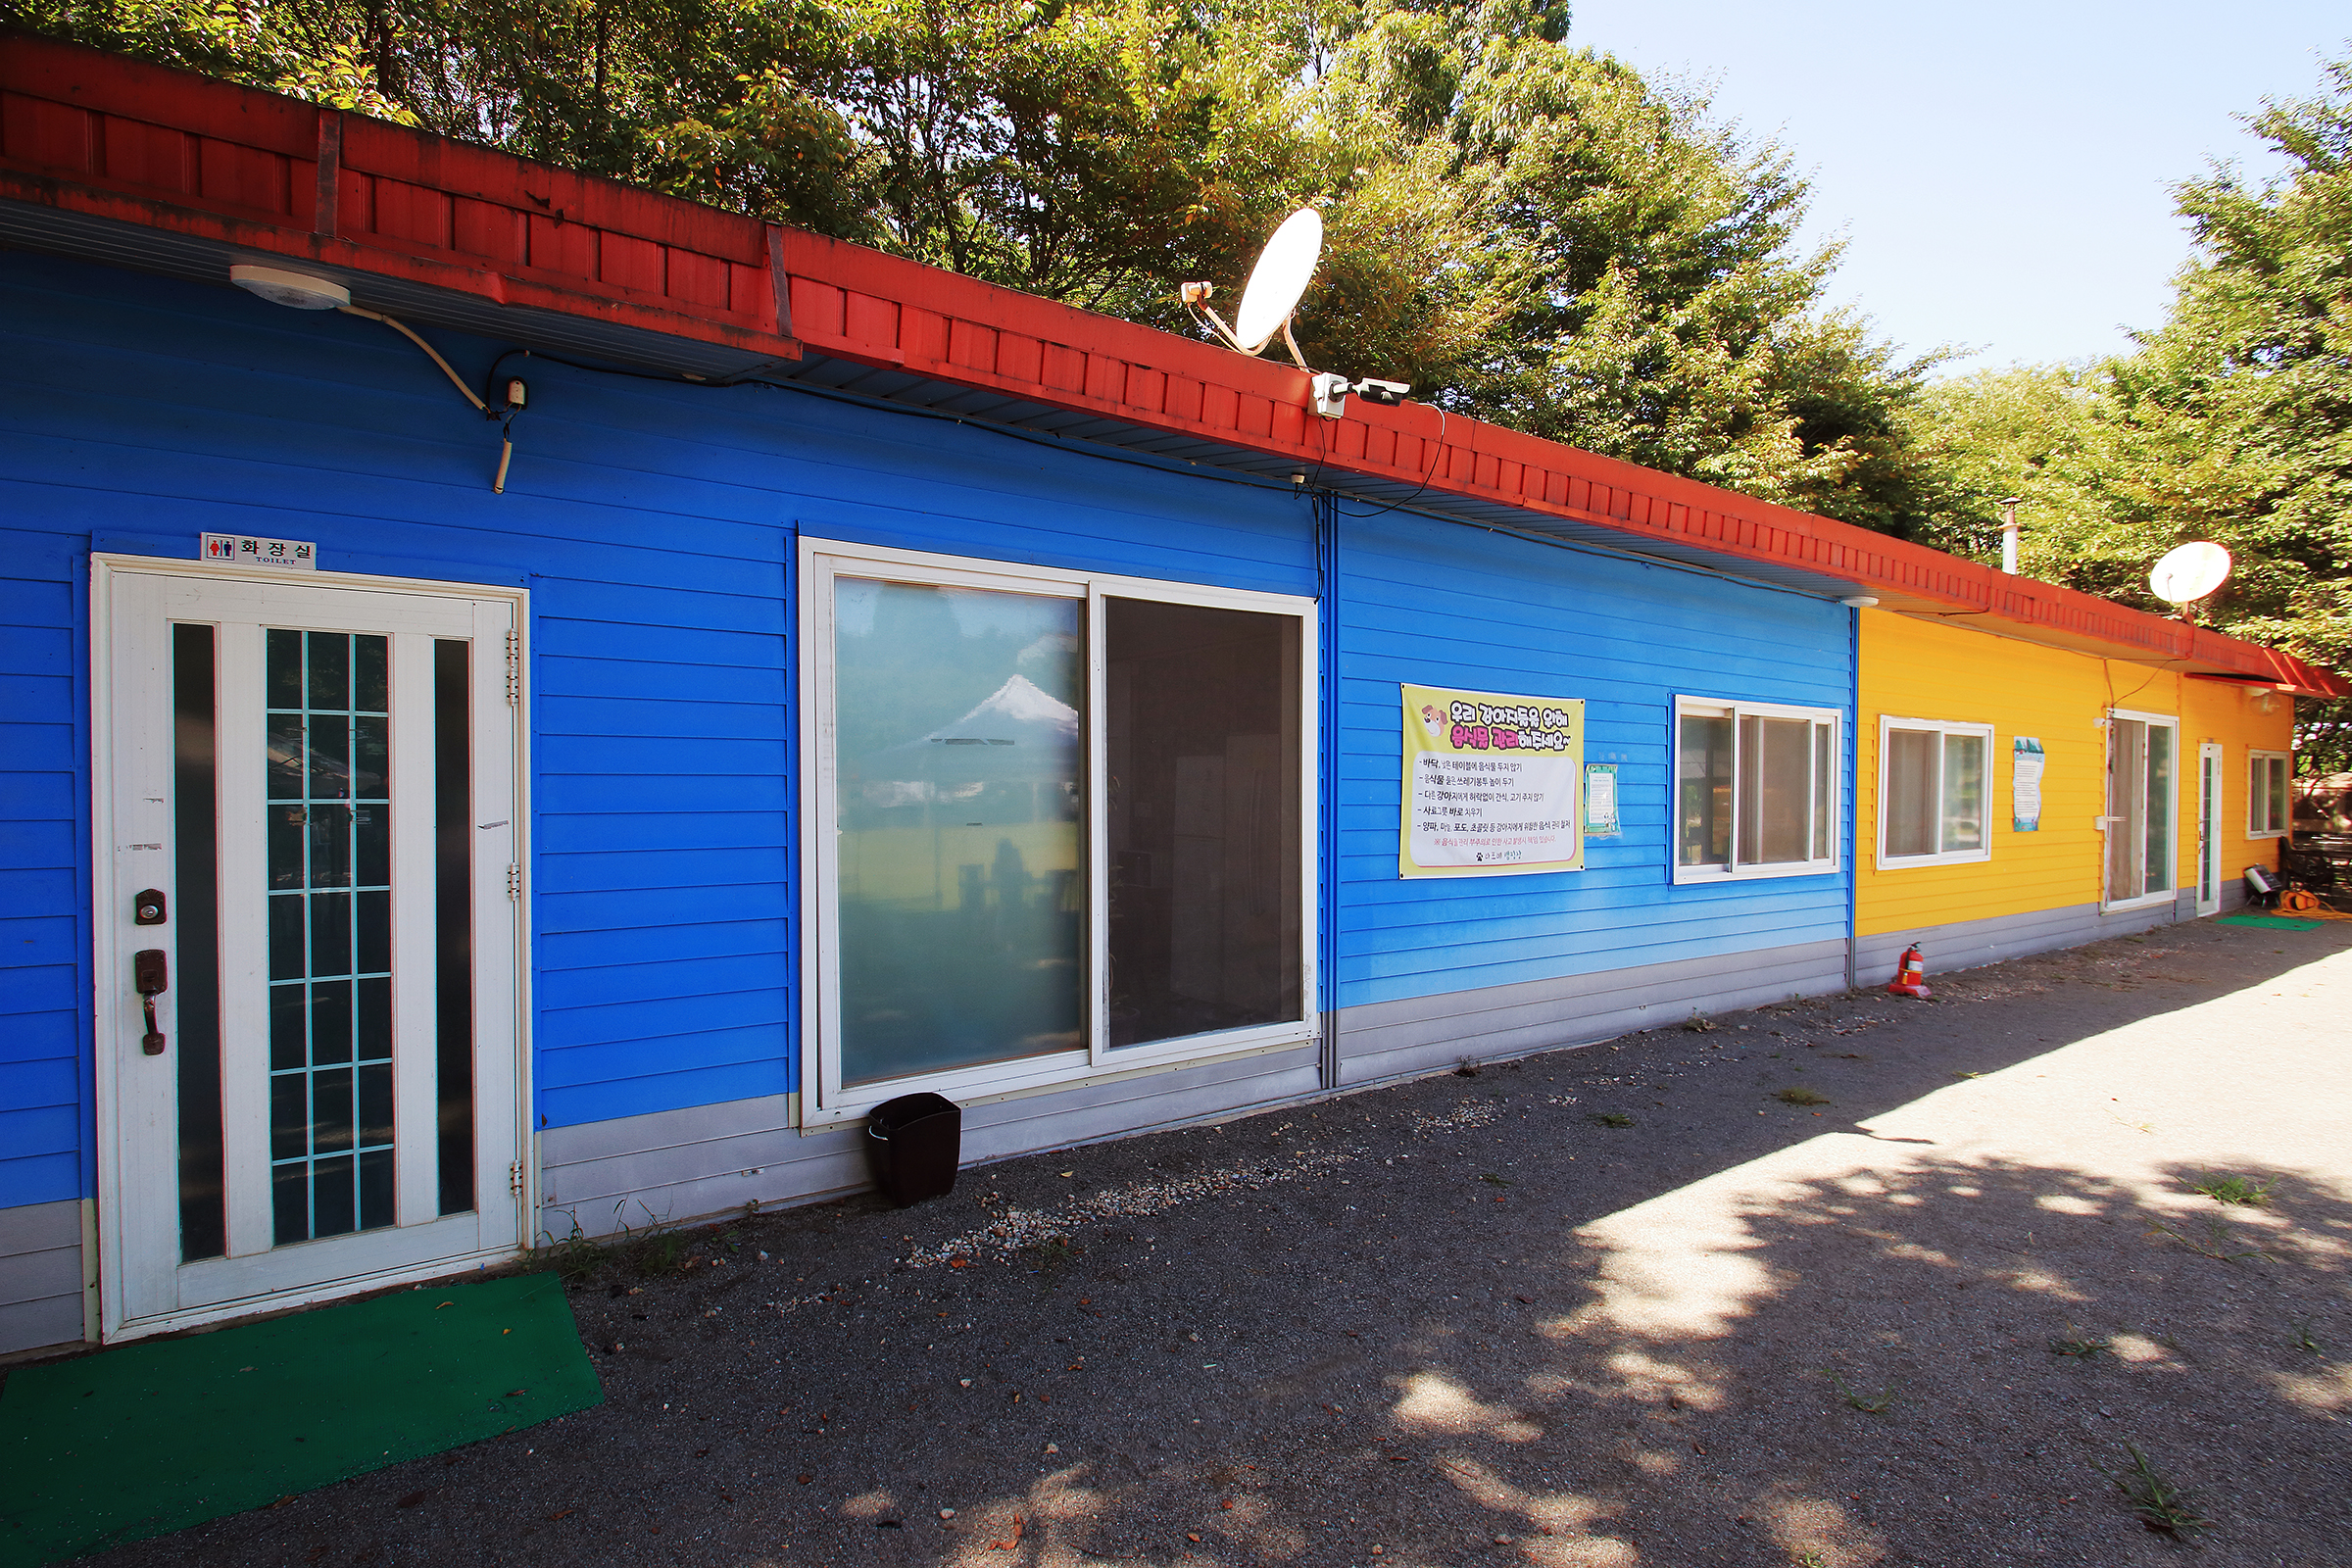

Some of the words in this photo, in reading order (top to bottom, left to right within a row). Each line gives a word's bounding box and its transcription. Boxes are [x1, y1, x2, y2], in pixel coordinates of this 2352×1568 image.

[241, 540, 311, 559] 화장실
[1450, 701, 1476, 723] 우리
[1478, 703, 1541, 728] 강아지들을
[1543, 708, 1568, 729] 위해
[1450, 725, 1489, 749] 음식물
[1452, 761, 1477, 770] 테이블에
[1479, 761, 1495, 771] 음식물
[1497, 762, 1509, 771] 두지
[1425, 774, 1445, 785] 음식물
[1490, 778, 1500, 787] 높이
[1502, 778, 1513, 787] 두기
[1425, 791, 1436, 800] 다른
[1437, 791, 1468, 801] 강아지에게
[1470, 792, 1494, 802] 허락없이
[1510, 793, 1521, 802] 고기
[1522, 793, 1533, 802] 주지
[1423, 807, 1447, 816] 사료그릇
[1449, 808, 1463, 816] 바로
[1465, 808, 1483, 817] 치우기
[1423, 822, 1439, 831] 양파,
[1453, 823, 1468, 832] 포도,
[1490, 823, 1495, 832] 등
[1496, 822, 1523, 832] 강아지에게
[1539, 821, 1550, 831] 음식
